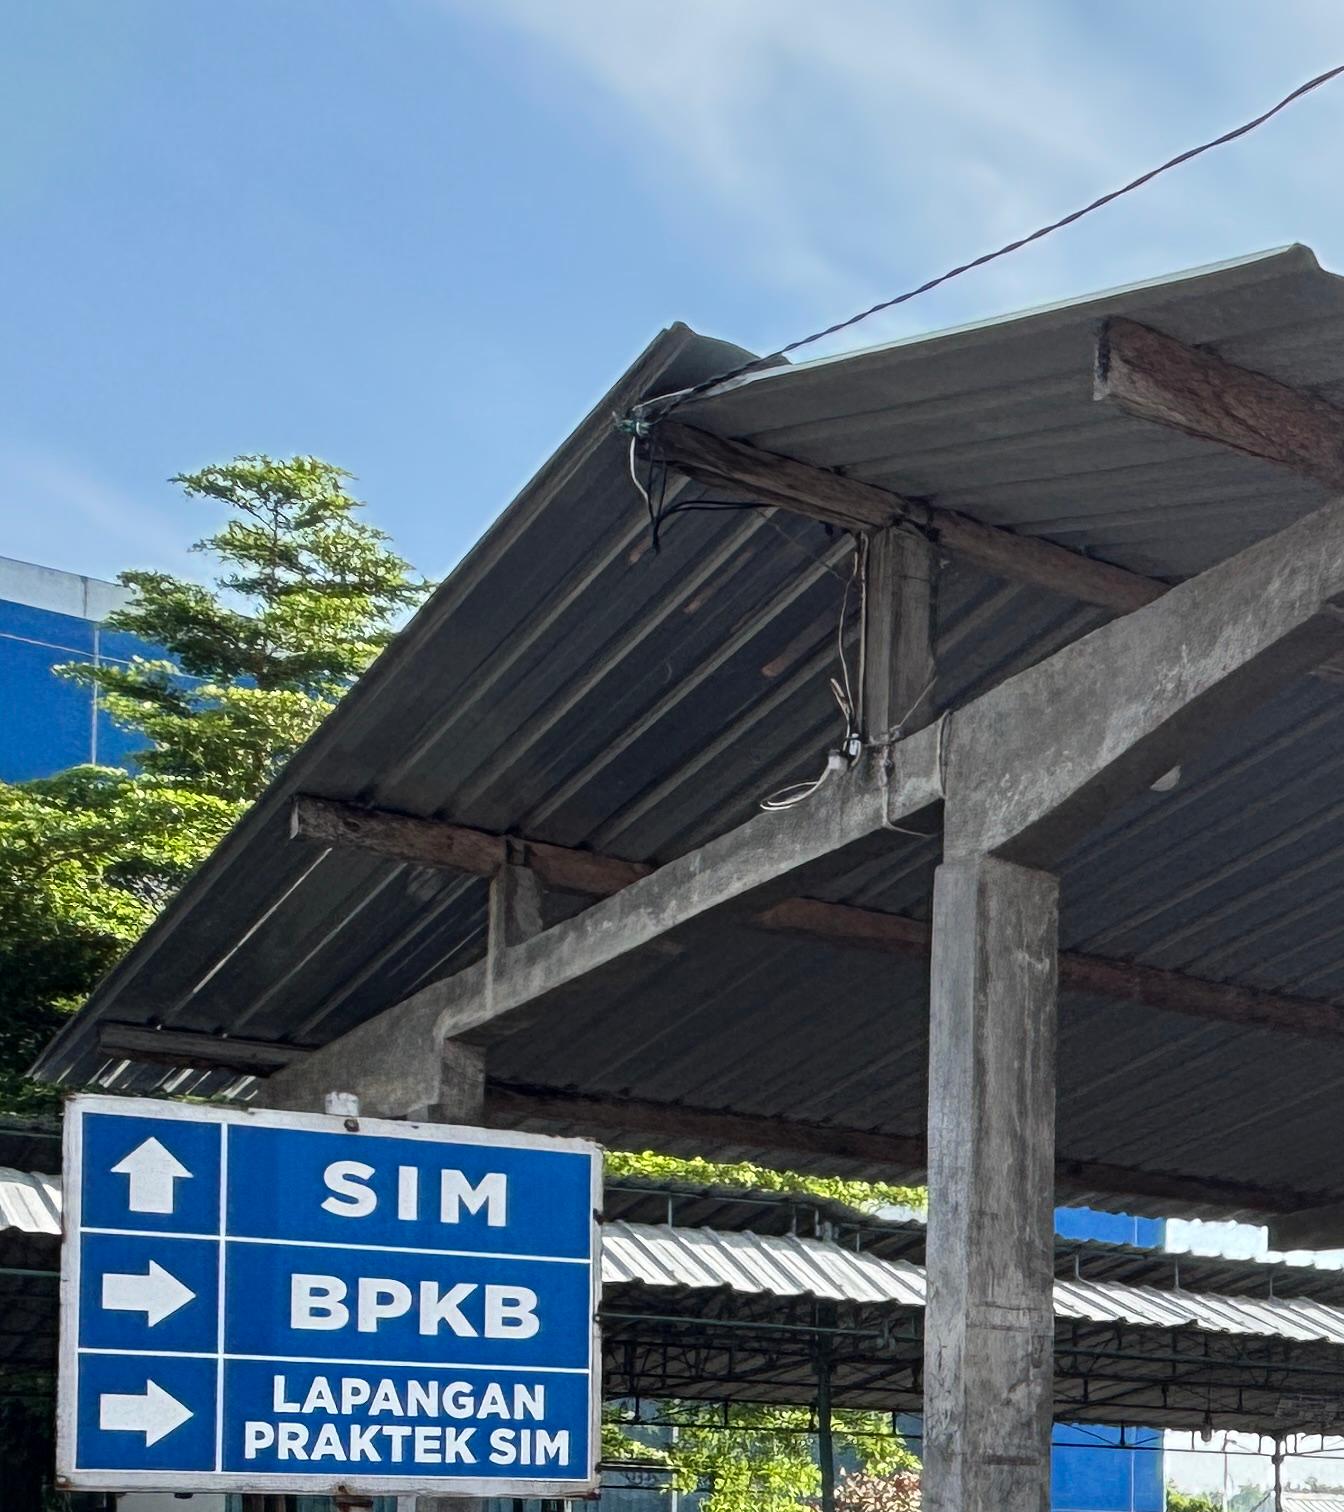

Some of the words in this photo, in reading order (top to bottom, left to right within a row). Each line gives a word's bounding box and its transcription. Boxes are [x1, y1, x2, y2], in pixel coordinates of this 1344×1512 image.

[321, 1160, 508, 1227] SIM
[290, 1273, 541, 1338] BPKB
[273, 1375, 545, 1421] LAPANGAN
[244, 1421, 477, 1464] PRAKTEK
[488, 1428, 570, 1466] SIM
